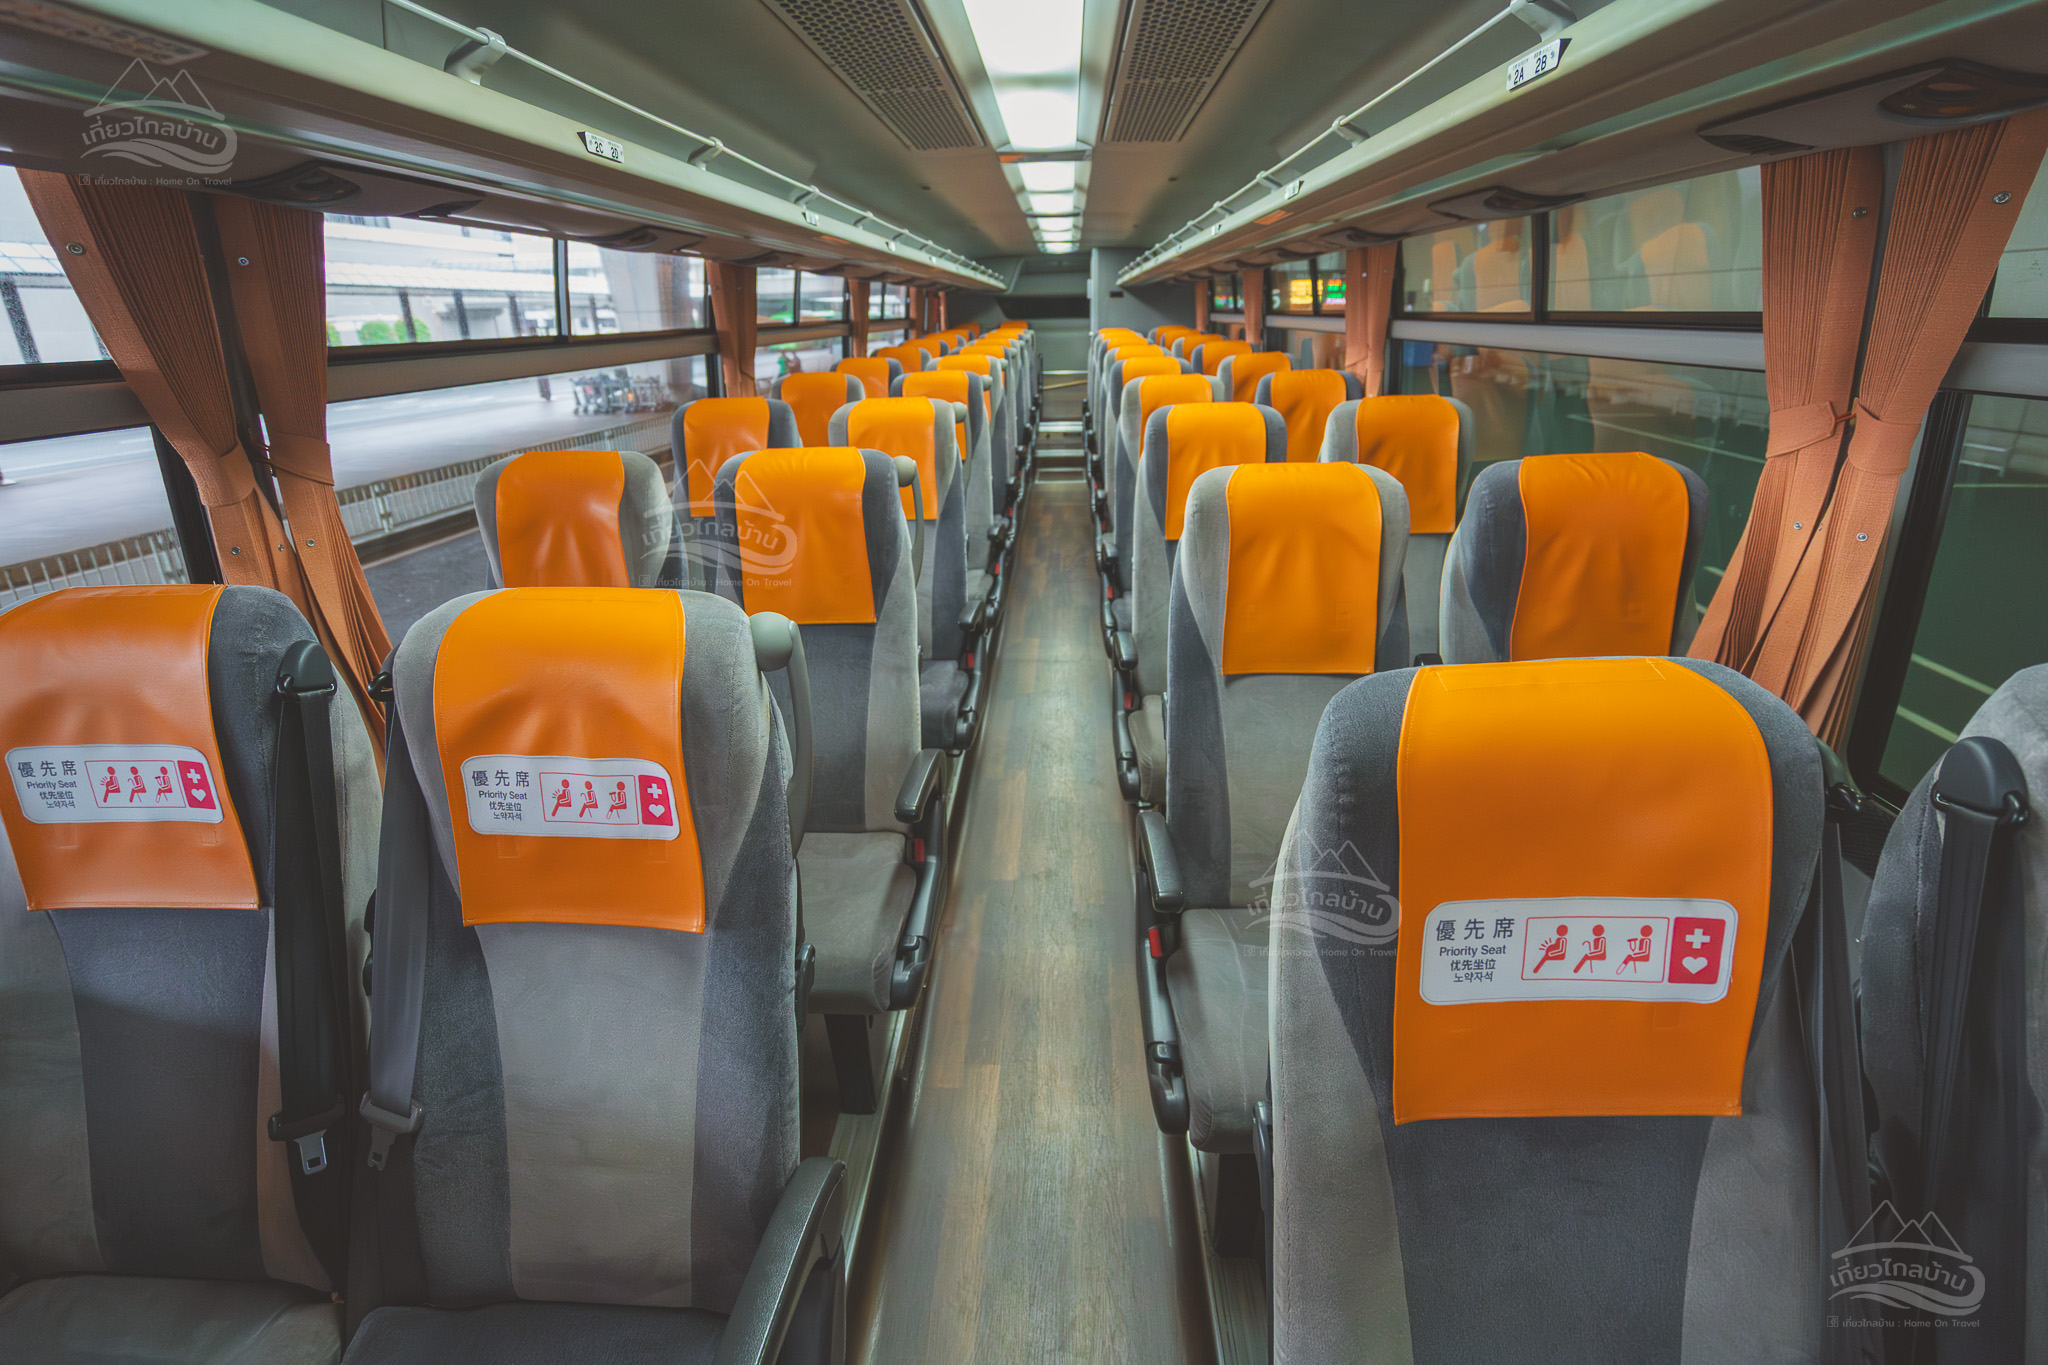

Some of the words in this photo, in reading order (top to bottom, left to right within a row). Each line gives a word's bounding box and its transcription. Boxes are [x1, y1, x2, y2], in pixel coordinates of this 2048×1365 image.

[1513, 66, 1524, 85] 2A
[1535, 54, 1547, 74] 2B
[594, 140, 603, 154] 2C
[17, 760, 77, 778] 優先席
[27, 781, 56, 790] Priority
[59, 780, 77, 788] Seat
[472, 769, 529, 788] 優先席
[478, 790, 507, 800] Priority
[509, 791, 527, 800] Seat
[46, 800, 75, 808] 노약자석
[493, 812, 522, 821] 노약자석
[1436, 917, 1515, 942] 優先席
[1439, 946, 1478, 958] Priority
[1482, 944, 1506, 955] Seat
[1453, 971, 1493, 983] 노약자석
